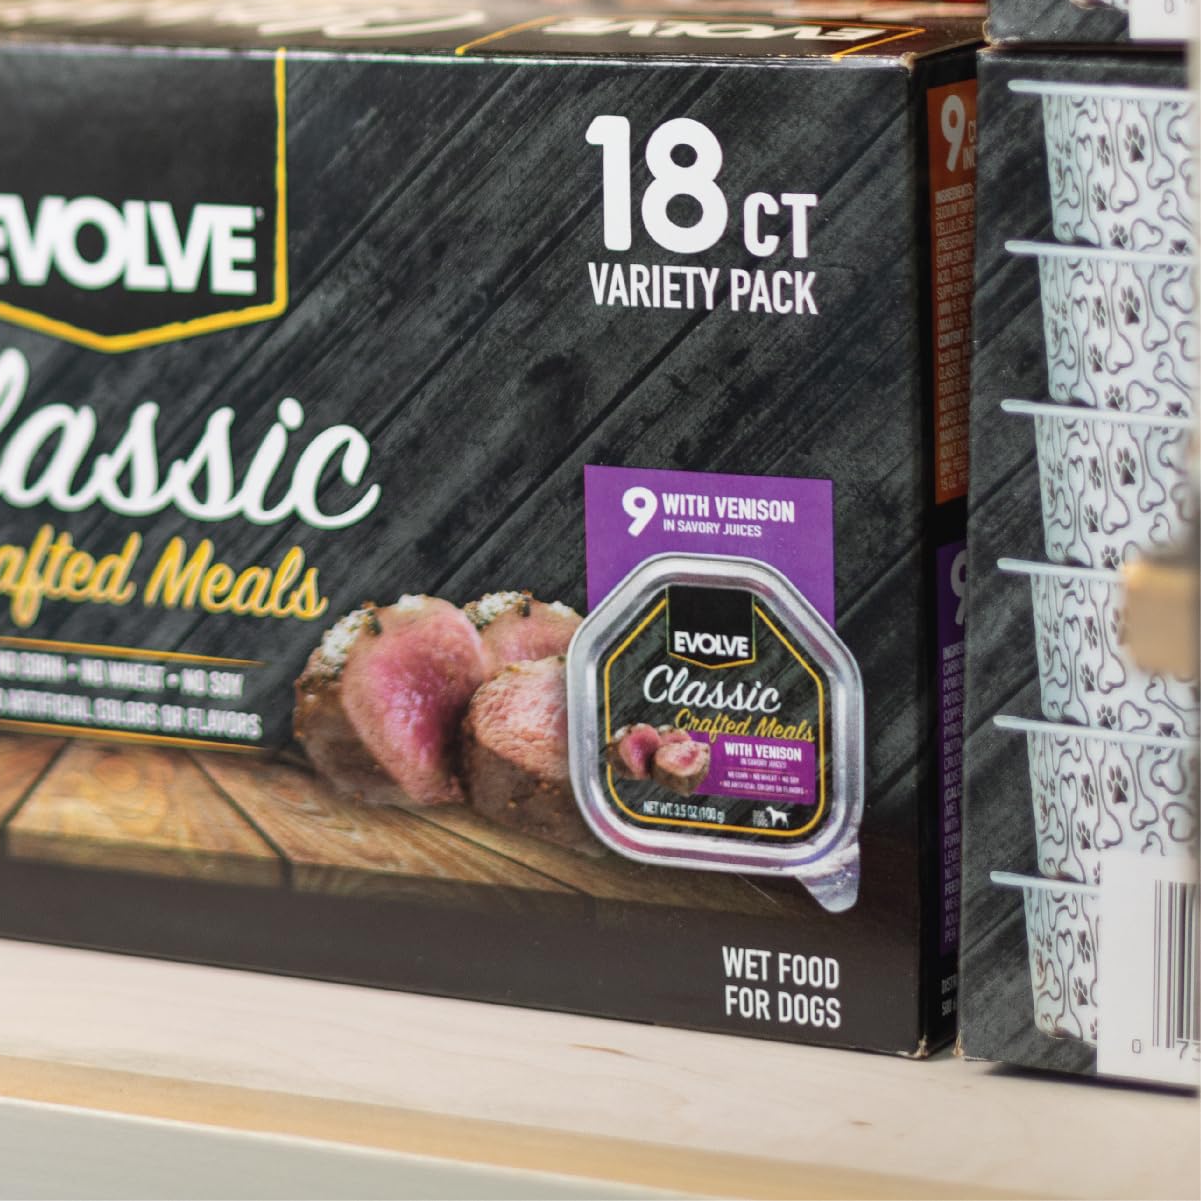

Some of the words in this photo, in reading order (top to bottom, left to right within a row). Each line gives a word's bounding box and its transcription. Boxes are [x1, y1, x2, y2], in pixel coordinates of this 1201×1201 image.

[940, 94, 966, 172] 9
[585, 114, 728, 254] 18
[743, 191, 818, 259] CT
[588, 261, 720, 311] VARIETY
[730, 267, 819, 315] PACK
[622, 486, 658, 537] 9
[662, 493, 709, 518] WITH
[714, 496, 795, 523] VENISON
[663, 519, 675, 532] IN
[677, 520, 720, 535] SAVORY
[722, 523, 762, 538] JUICES
[144, 535, 329, 619] Meals
[673, 630, 749, 658] EVOLVE
[78, 658, 105, 688] NO
[107, 660, 167, 693] WHEAT
[180, 667, 208, 697] NO
[210, 670, 244, 700] SOY
[643, 664, 782, 713] Classic
[94, 697, 159, 731] COLORS
[160, 703, 185, 733] OR
[187, 706, 264, 741] FLAVORS
[675, 708, 752, 744] Crafted
[754, 715, 816, 743] Meals
[724, 742, 752, 757] WITH
[755, 744, 802, 762] VENISON
[643, 800, 659, 816] NET
[722, 945, 772, 981] WET
[779, 952, 840, 989] FOOD
[725, 984, 771, 1021] FOR
[778, 991, 842, 1029] DOGS
[1131, 1038, 1142, 1054] 0
